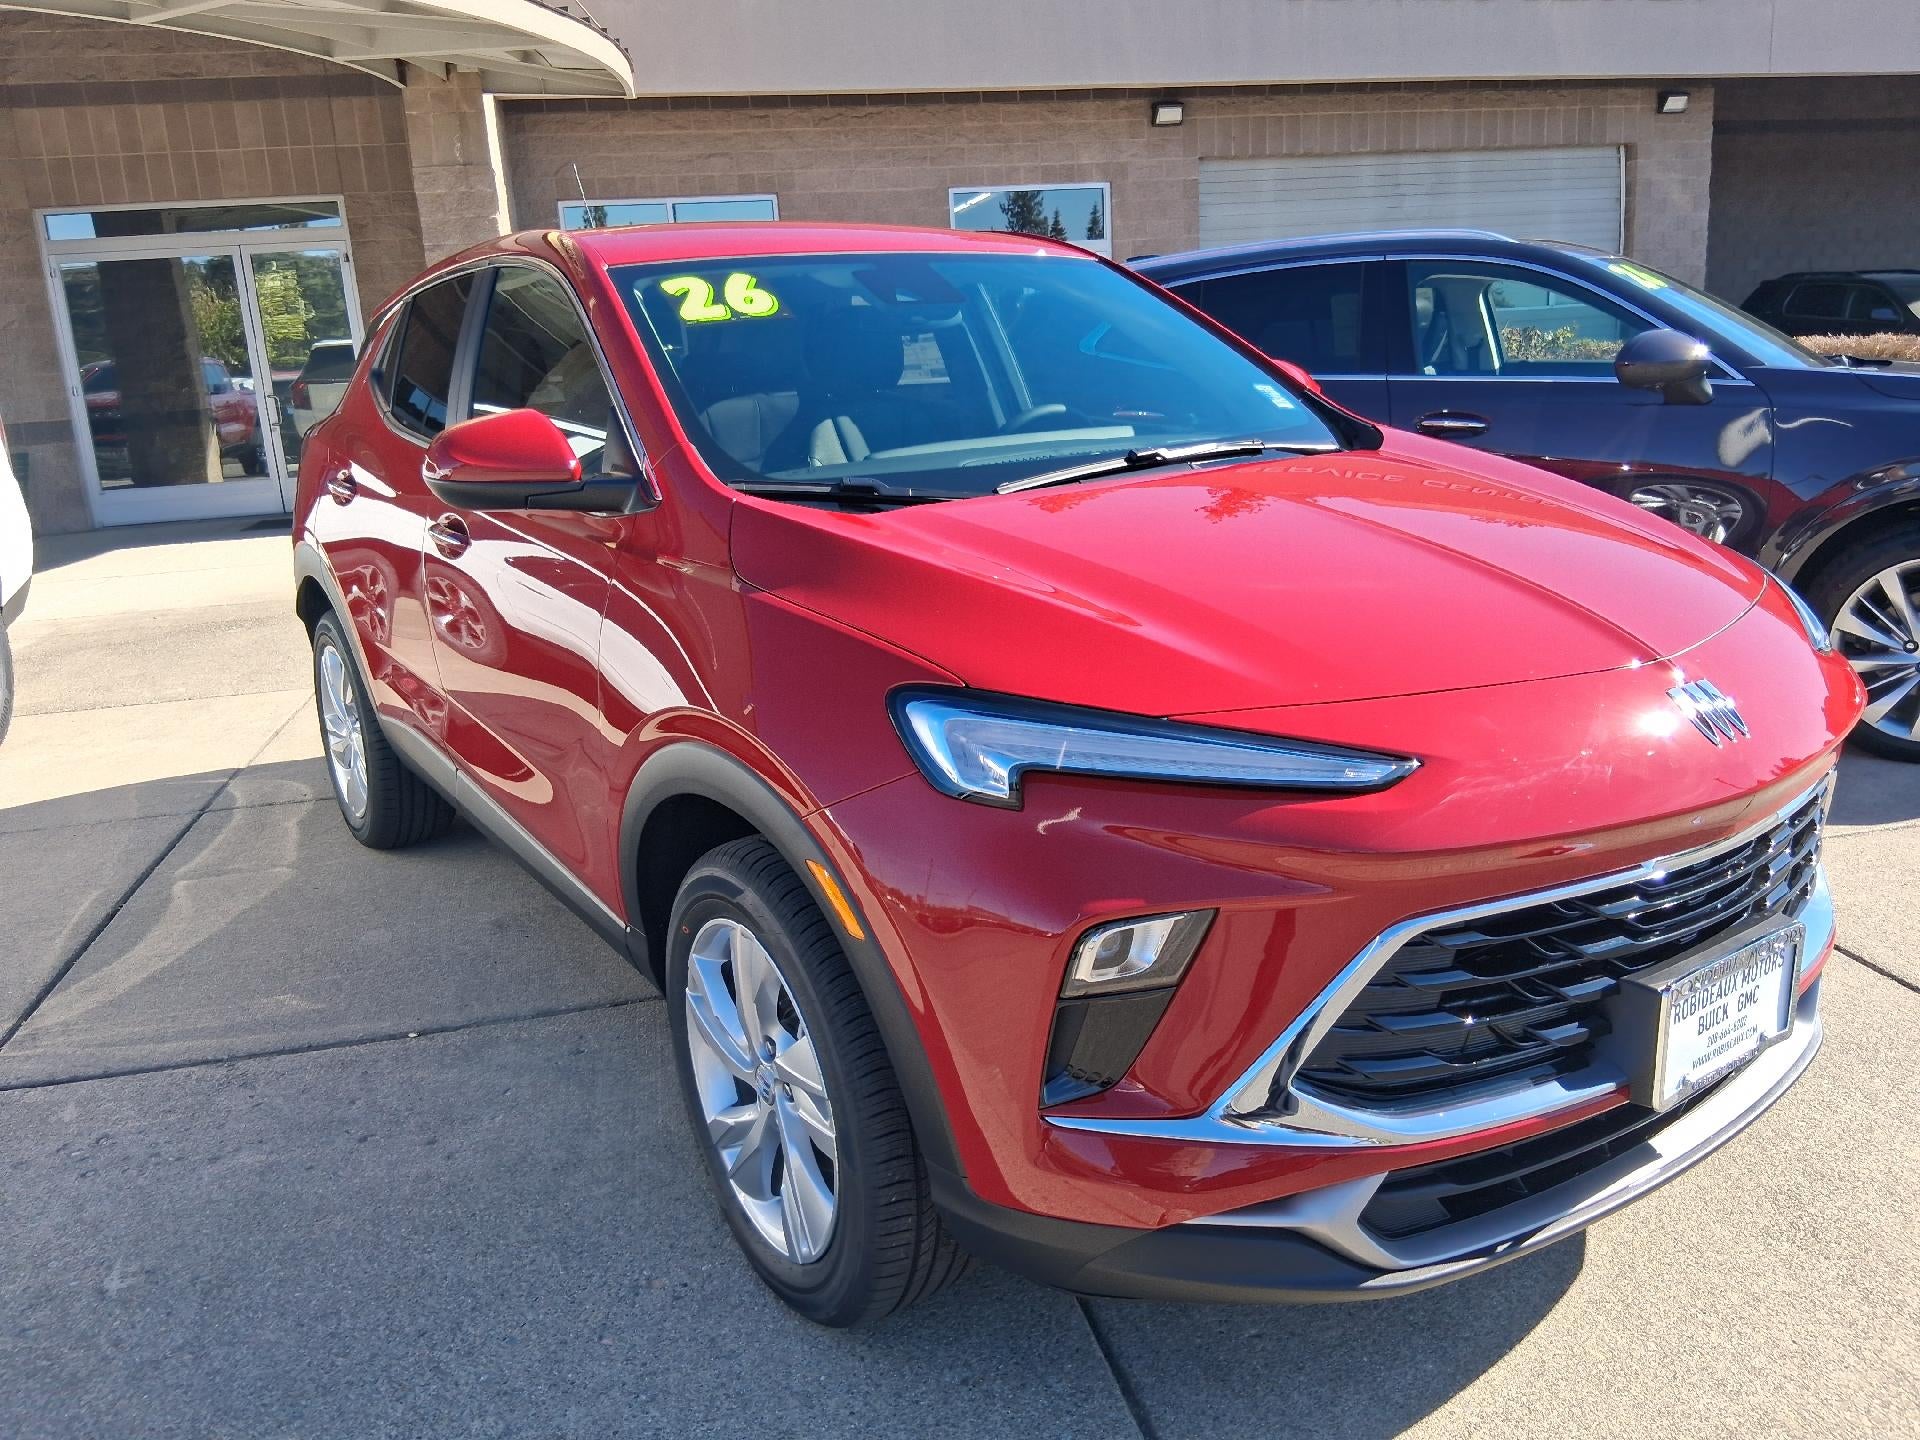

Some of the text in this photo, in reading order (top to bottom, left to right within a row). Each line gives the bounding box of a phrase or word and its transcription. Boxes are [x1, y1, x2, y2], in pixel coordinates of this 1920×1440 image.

[660, 272, 779, 321] 26
[1674, 949, 1785, 1025] ROBIDEAUX MOTORS
[1698, 985, 1760, 1036] BUICK GMC
